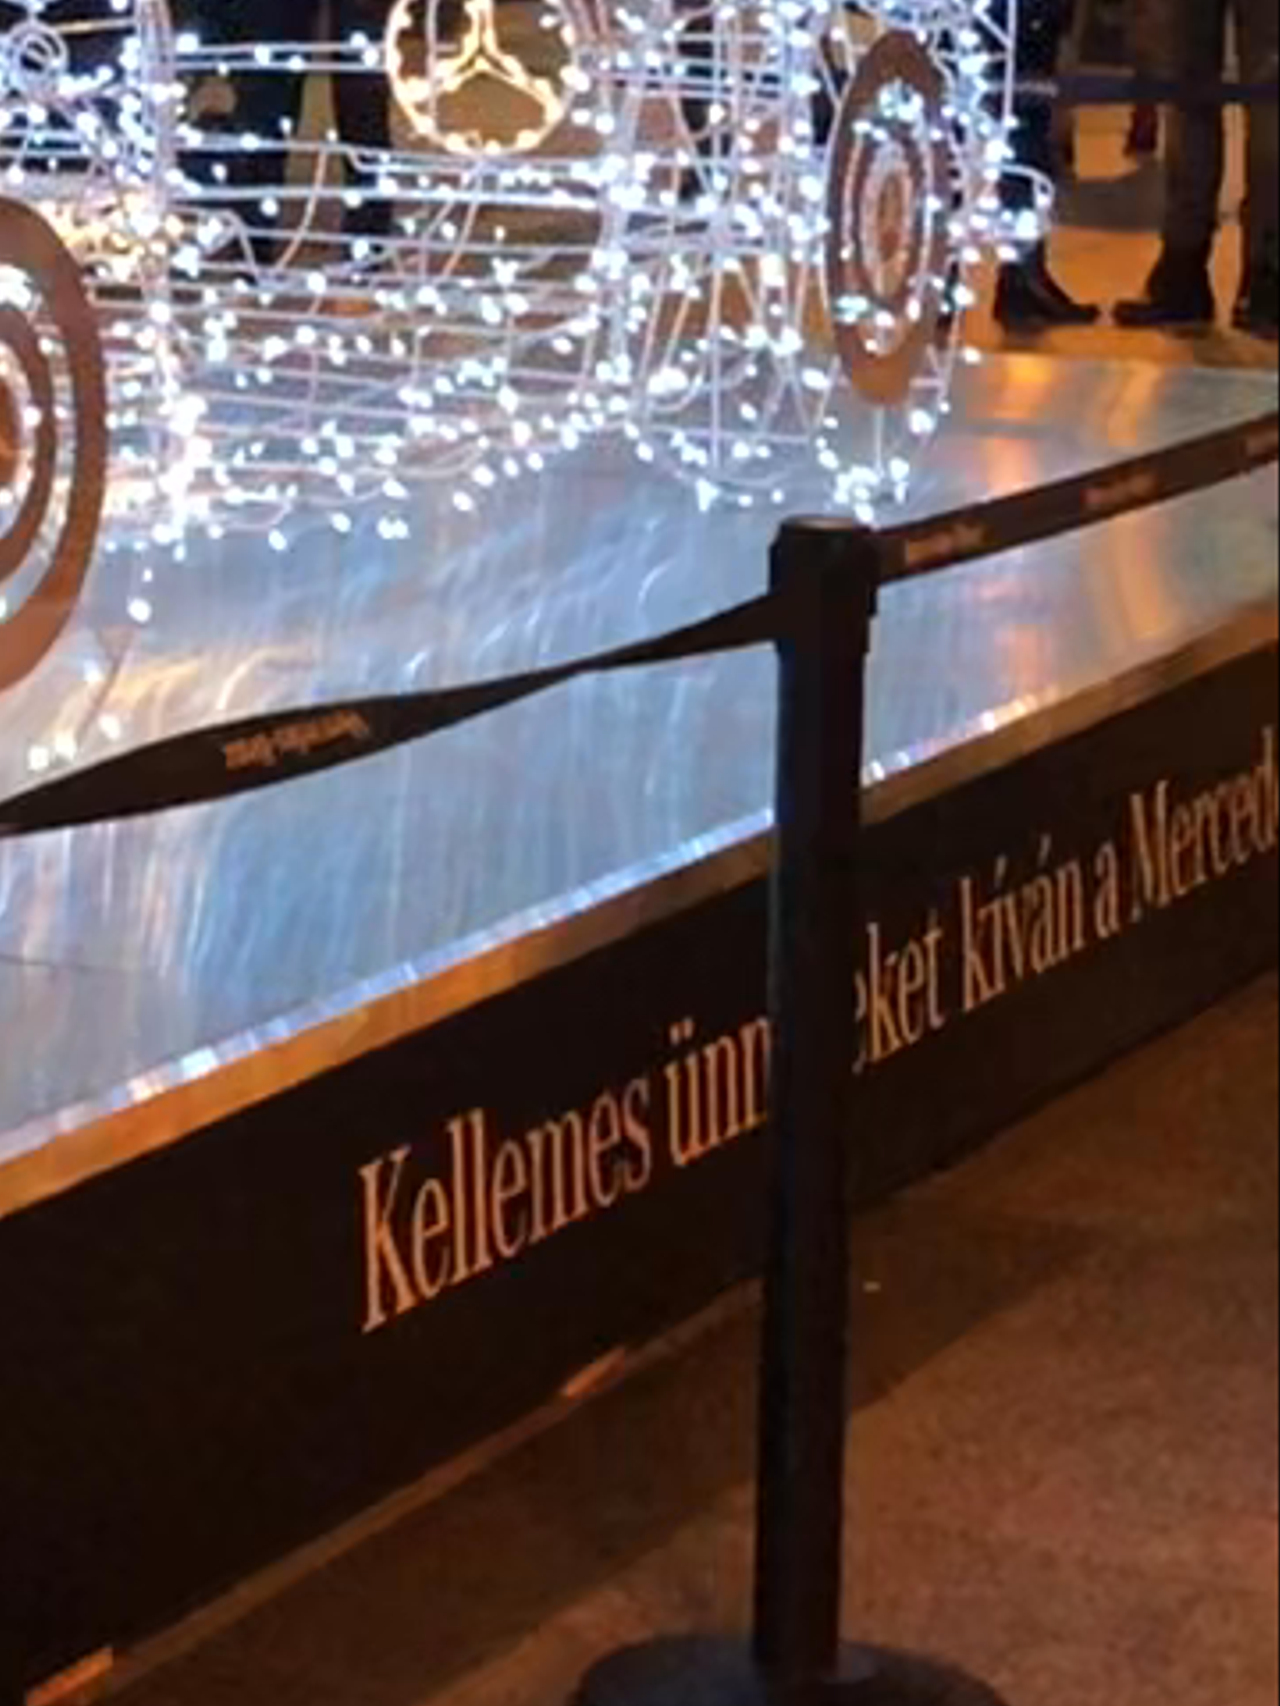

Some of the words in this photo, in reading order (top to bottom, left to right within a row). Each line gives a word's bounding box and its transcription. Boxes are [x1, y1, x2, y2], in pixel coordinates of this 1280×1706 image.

[359, 1077, 652, 1333] Kellemes
[958, 833, 1085, 1013] kíván
[1095, 838, 1120, 939] a
